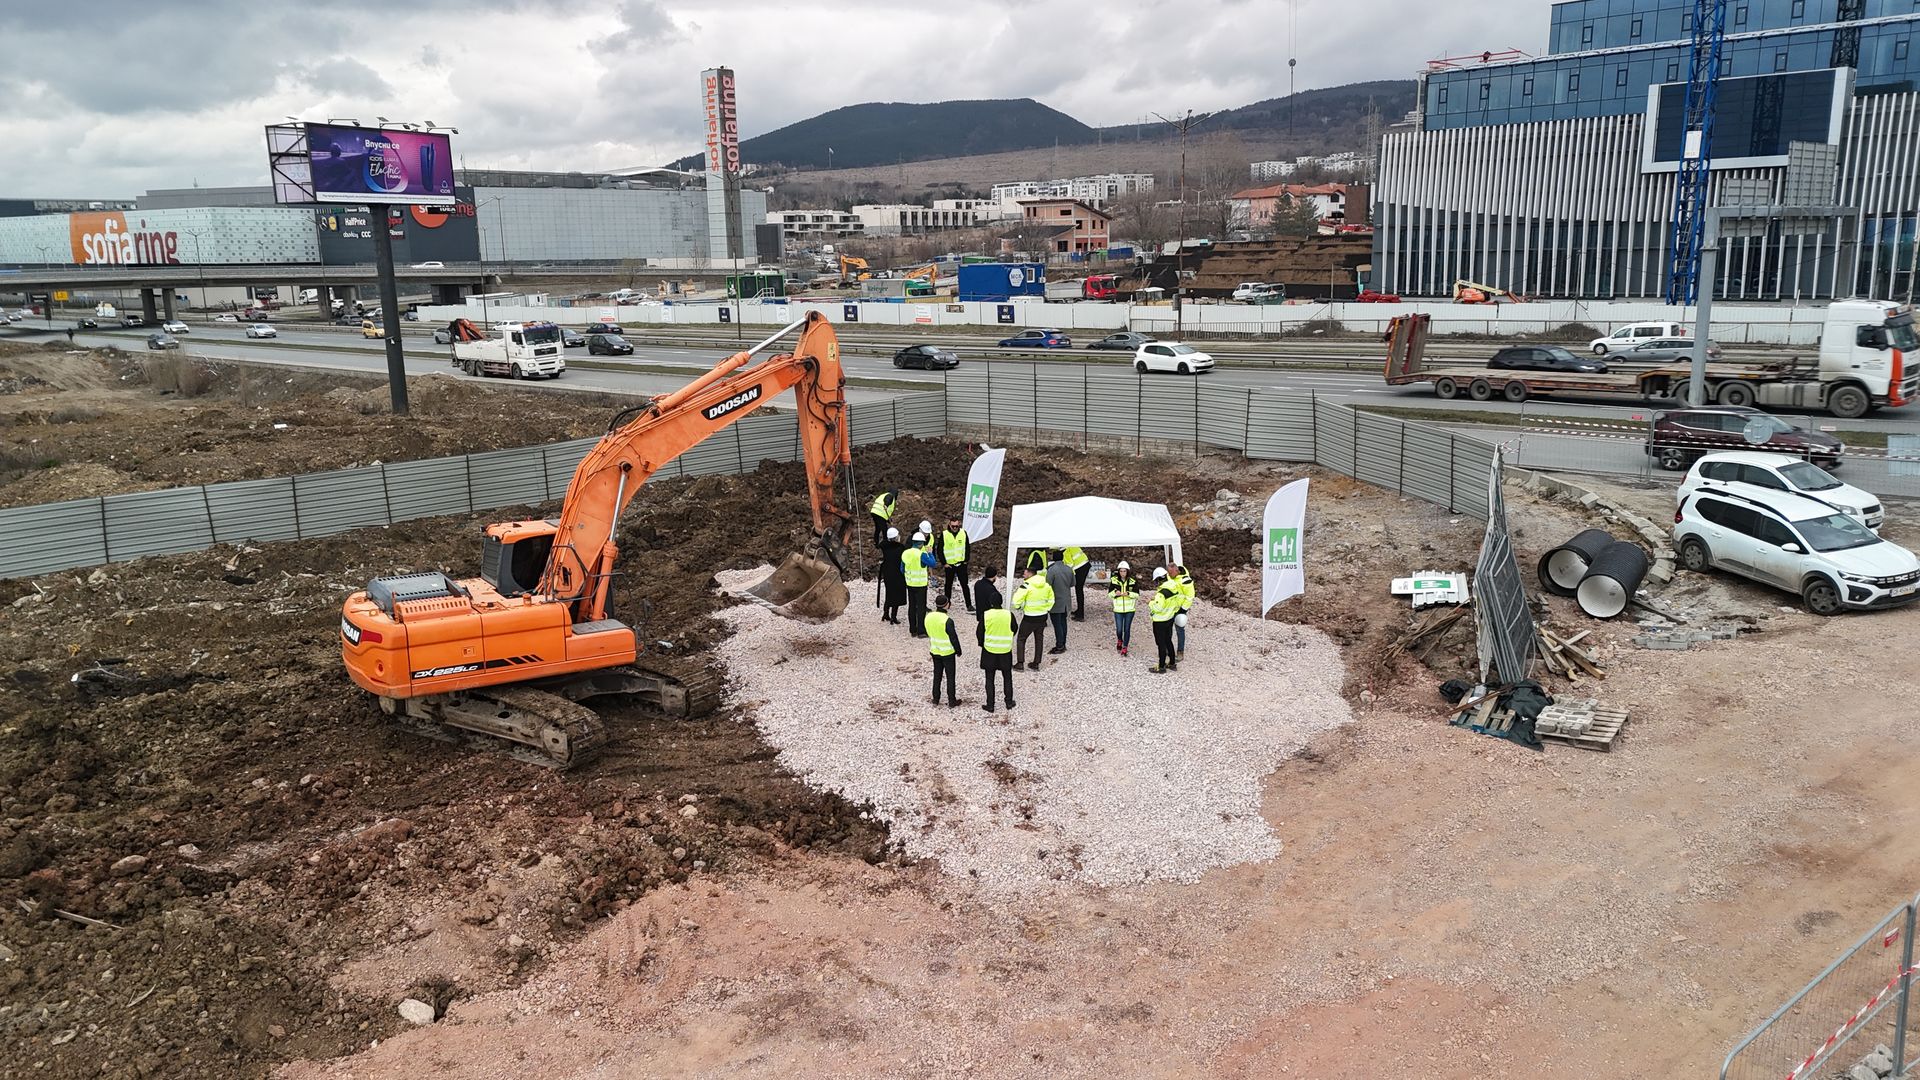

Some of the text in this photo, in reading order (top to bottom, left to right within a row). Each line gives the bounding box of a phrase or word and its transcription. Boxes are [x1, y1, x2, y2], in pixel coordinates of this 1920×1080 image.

[365, 140, 390, 150] Впусни
[370, 162, 401, 176] Electric
[709, 388, 758, 419] DOOSAN
